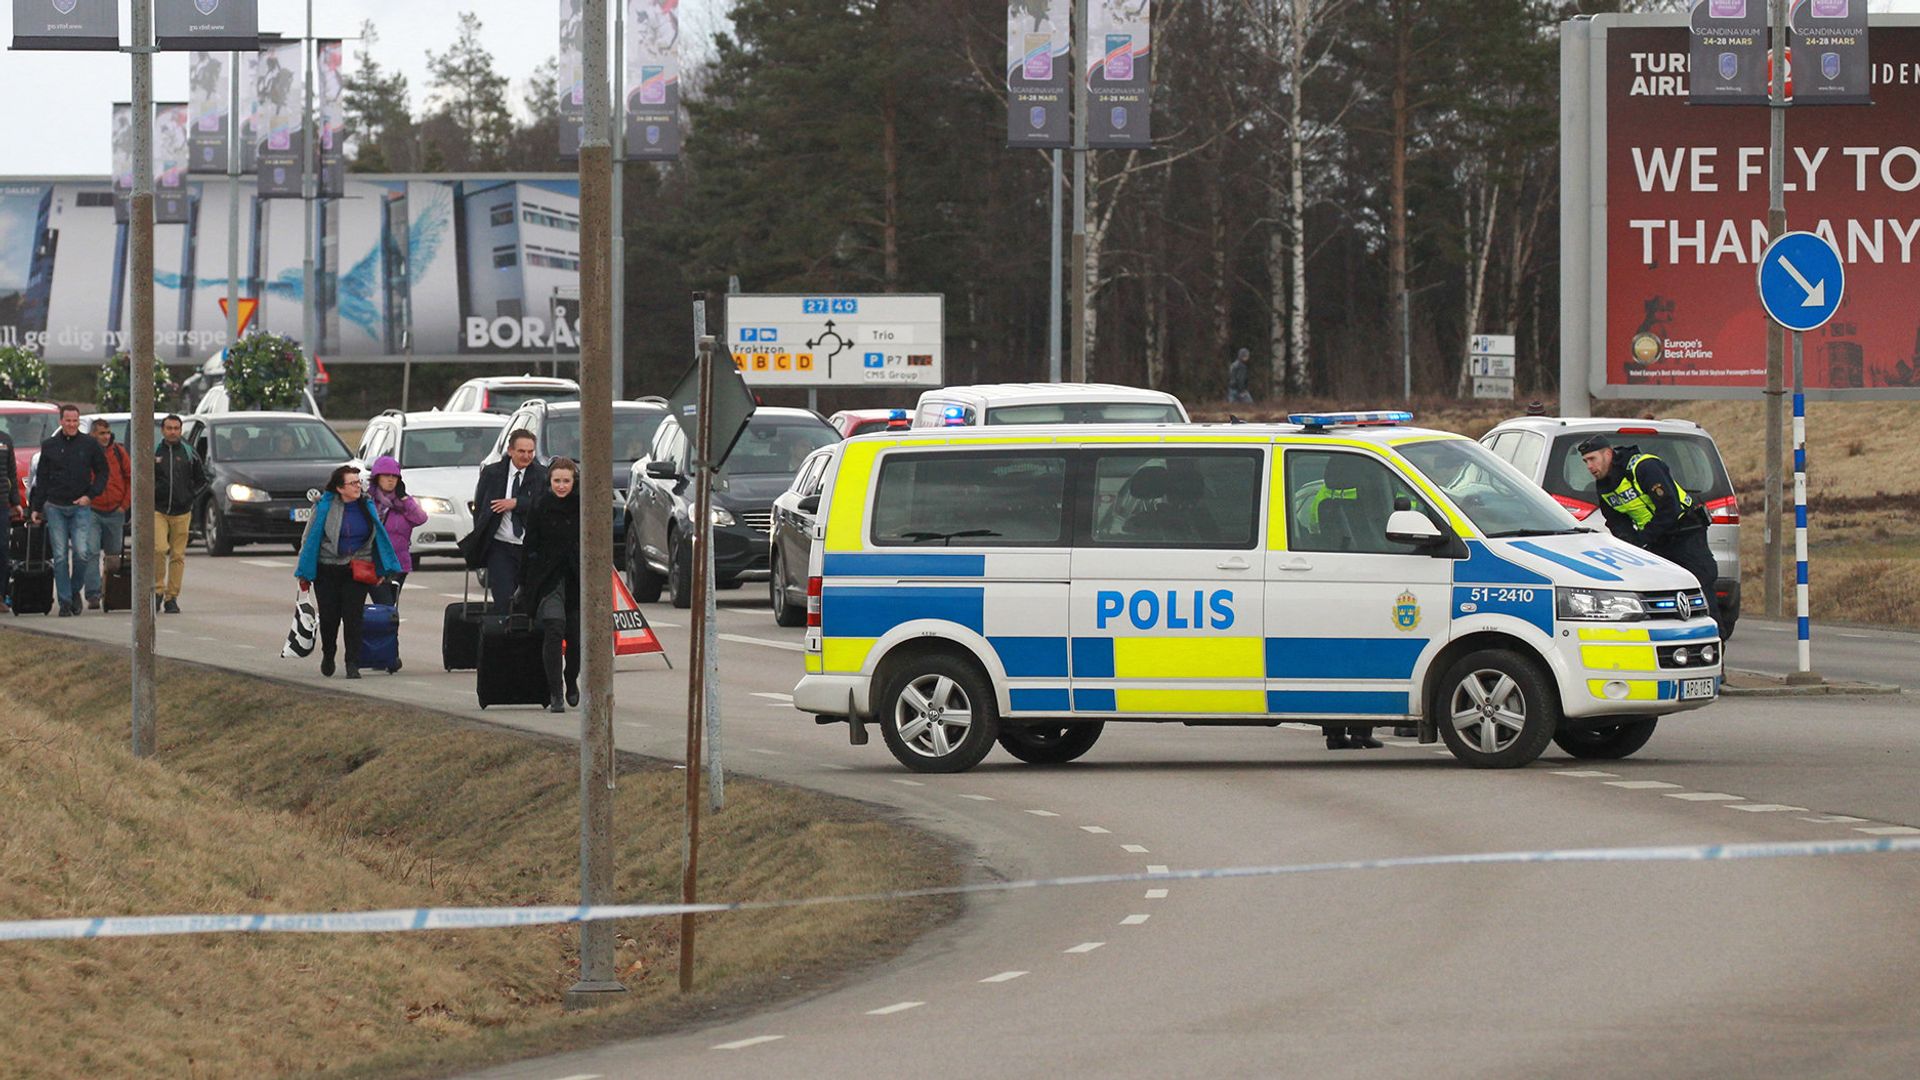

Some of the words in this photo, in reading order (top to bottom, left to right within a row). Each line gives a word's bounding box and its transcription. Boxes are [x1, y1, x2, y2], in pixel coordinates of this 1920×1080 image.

[1695, 27, 1760, 36] SCANDINAVIUM
[1798, 27, 1863, 36] SCANDINAVIUM
[1703, 37, 1727, 46] 24-28
[1728, 37, 1753, 46] MARS
[1805, 37, 1829, 45] 24-28
[1830, 37, 1855, 45] MARS
[1630, 53, 1691, 73] TUR
[1871, 63, 1920, 84] IDE
[1011, 86, 1064, 94] SCANDINAVIUM
[1093, 87, 1145, 95] SCANDINAVIUM
[1018, 94, 1037, 102] 24-28
[1038, 94, 1057, 102] MARS
[1631, 147, 1718, 192] WE
[1843, 146, 1920, 192] TO
[807, 301, 825, 312] 27
[833, 301, 854, 312] 40
[24, 330, 50, 352] ge
[58, 326, 95, 353] dig
[101, 330, 132, 352] ny
[872, 329, 895, 340] Trio
[1664, 338, 1703, 350] Europe's
[1664, 350, 1684, 359] Best
[1685, 350, 1713, 359] Airline
[756, 355, 766, 369] B
[777, 355, 787, 369] C
[799, 355, 810, 369] D
[864, 370, 885, 379] CMS
[888, 370, 918, 380] Group
[1581, 546, 1660, 571] POL
[1470, 587, 1534, 603] 51-2410
[1096, 589, 1236, 631] POLIS
[613, 611, 643, 630] POLIS
